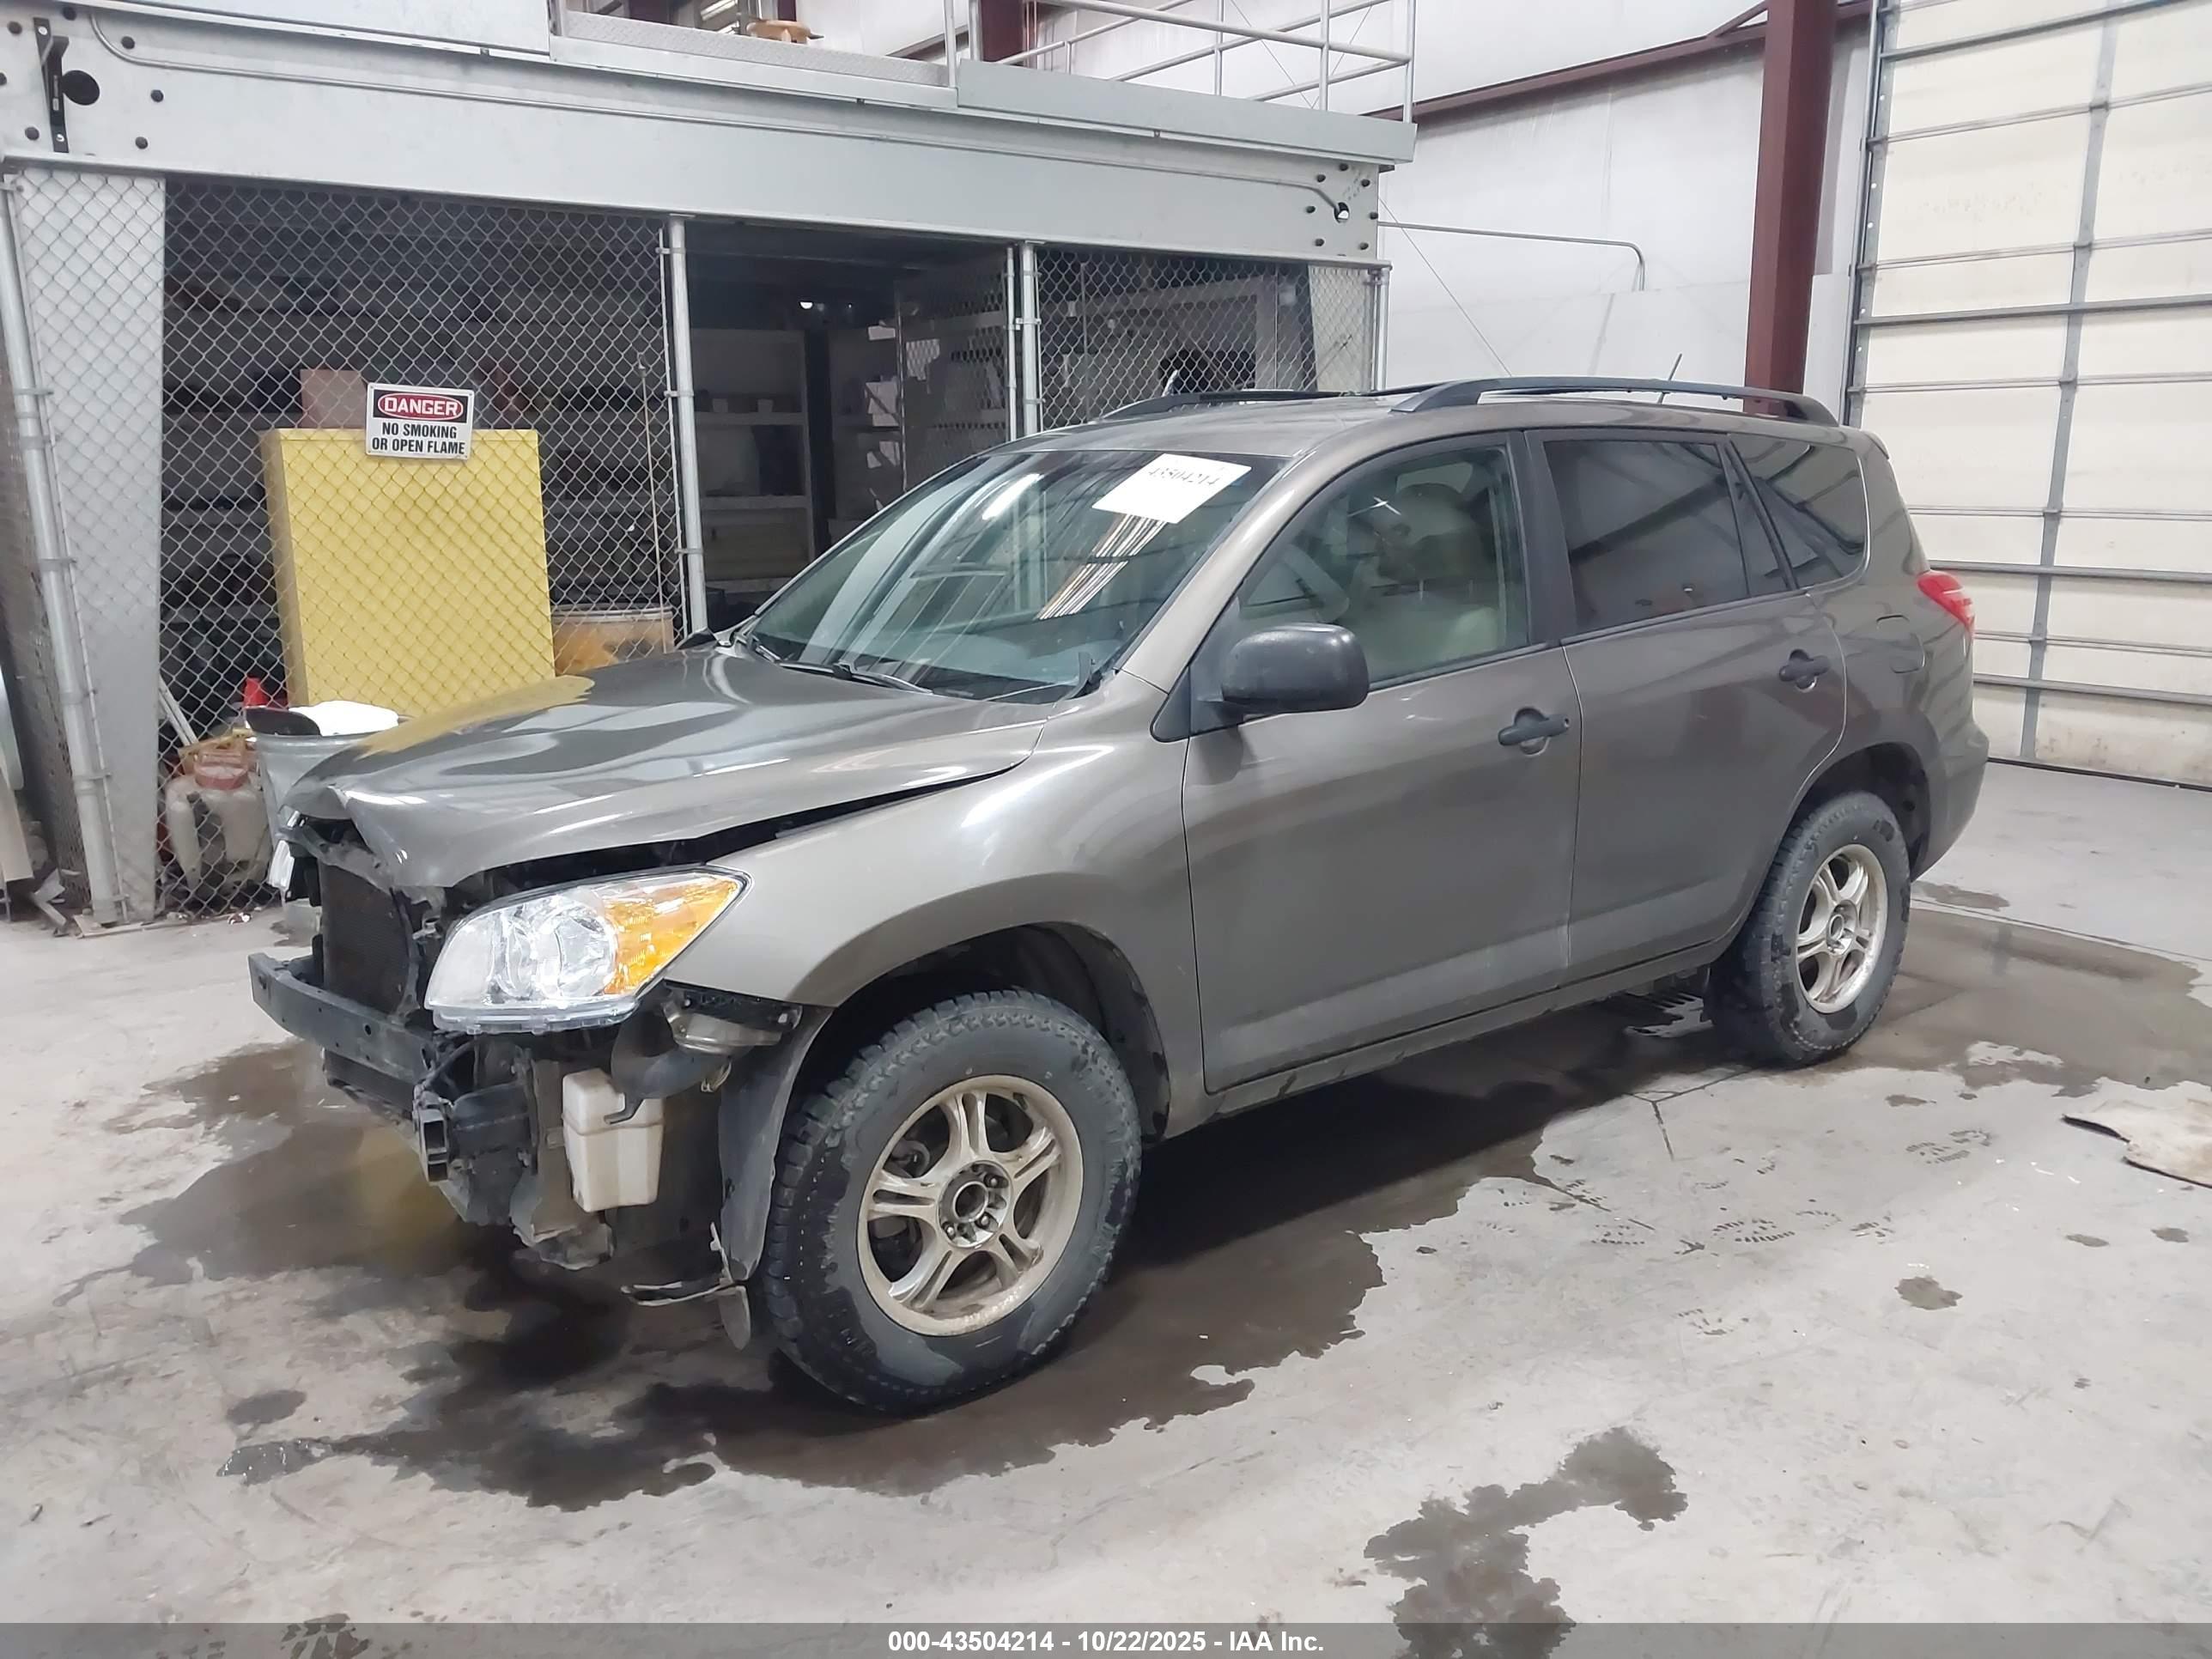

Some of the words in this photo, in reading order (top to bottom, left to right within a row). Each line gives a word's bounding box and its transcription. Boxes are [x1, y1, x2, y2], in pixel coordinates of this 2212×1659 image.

[384, 397, 459, 416] DANGER
[382, 422, 399, 435] NO
[403, 423, 457, 439] SMOKING
[372, 437, 388, 451] OR
[392, 438, 423, 453] OPEN
[427, 441, 465, 455] FLAME
